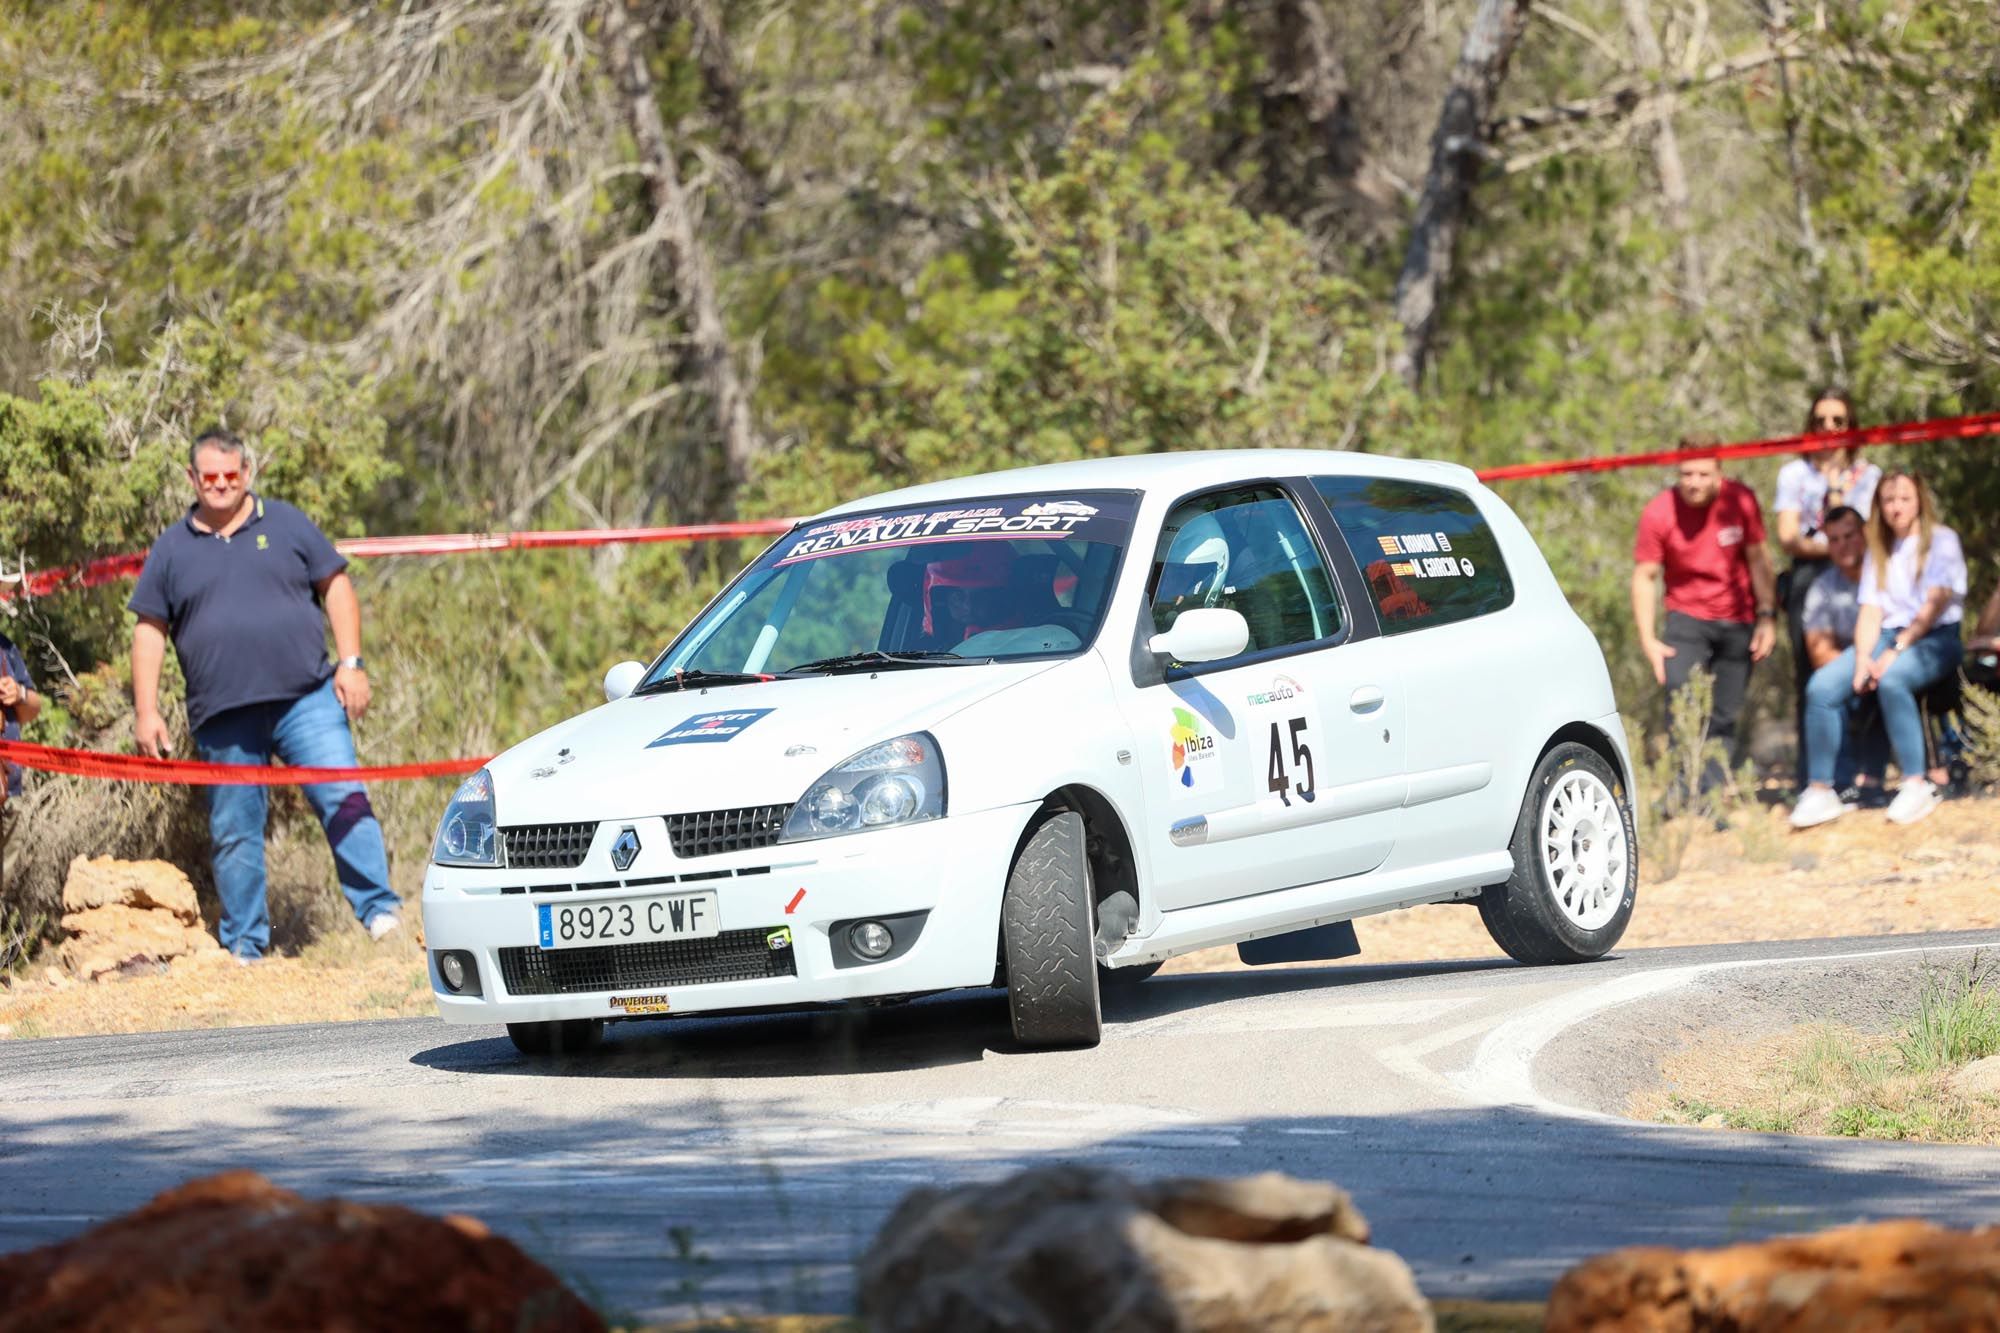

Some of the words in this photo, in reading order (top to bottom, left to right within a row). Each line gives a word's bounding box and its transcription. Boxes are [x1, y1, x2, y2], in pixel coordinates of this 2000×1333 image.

[785, 518, 948, 558] RENAULT
[945, 516, 1091, 535] SPORT
[1247, 685, 1294, 706] mecauto
[1185, 733, 1214, 753] Ibiza
[1268, 716, 1316, 808] 45
[1622, 810, 1637, 893] MICHELIN
[543, 930, 550, 940] E
[560, 903, 635, 941] 8923
[647, 898, 706, 934] CWF
[609, 994, 668, 1009] POWERFLEX
